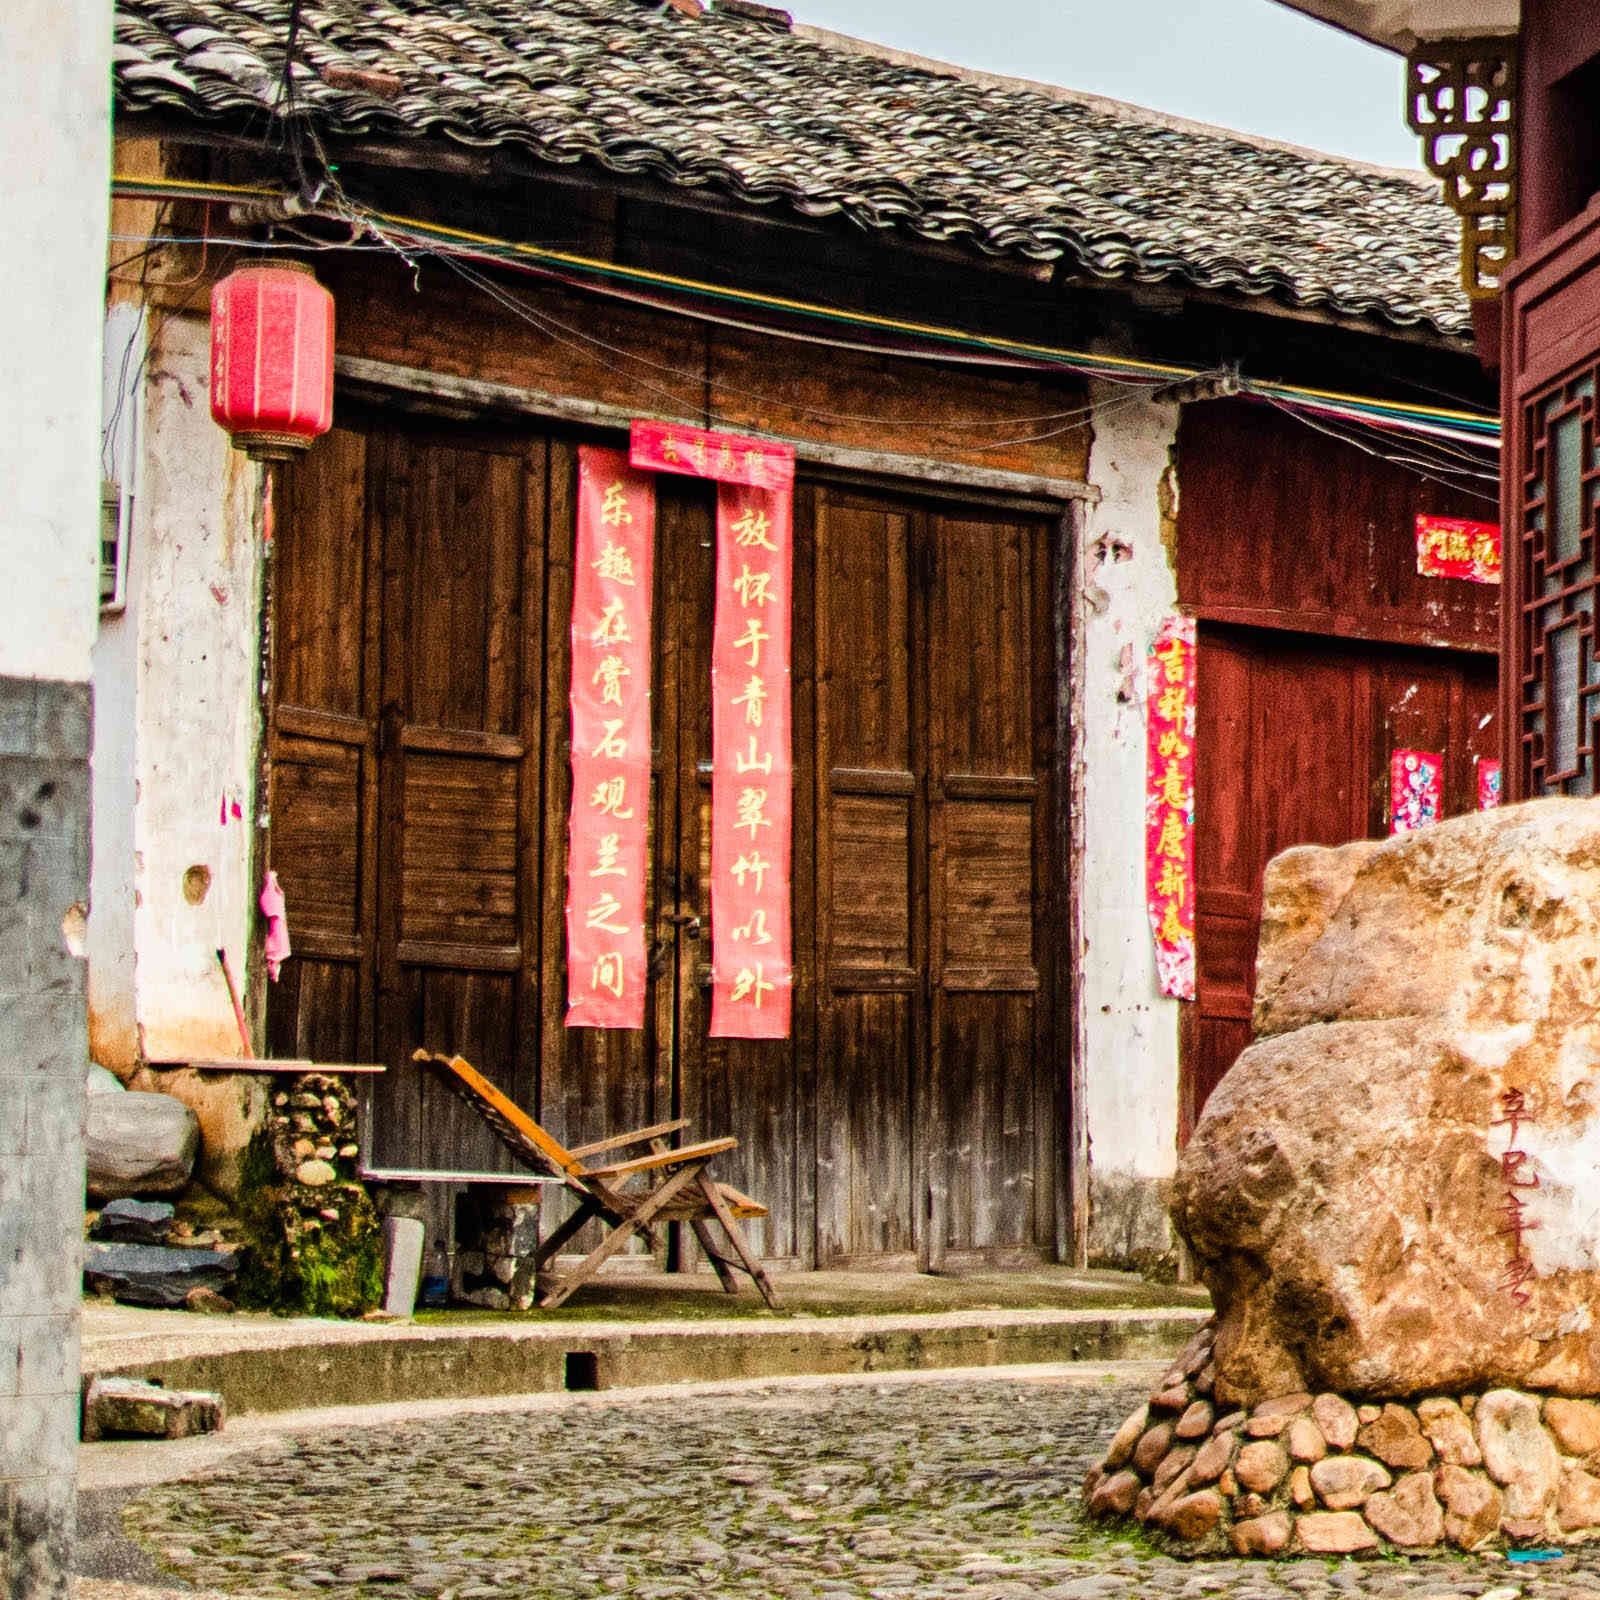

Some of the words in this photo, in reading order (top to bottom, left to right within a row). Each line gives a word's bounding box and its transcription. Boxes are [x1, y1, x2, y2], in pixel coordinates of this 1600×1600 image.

[584, 480, 637, 999] 乐趣在赏石观兰之间
[729, 507, 780, 1011] 放怀于青山翠竹以外
